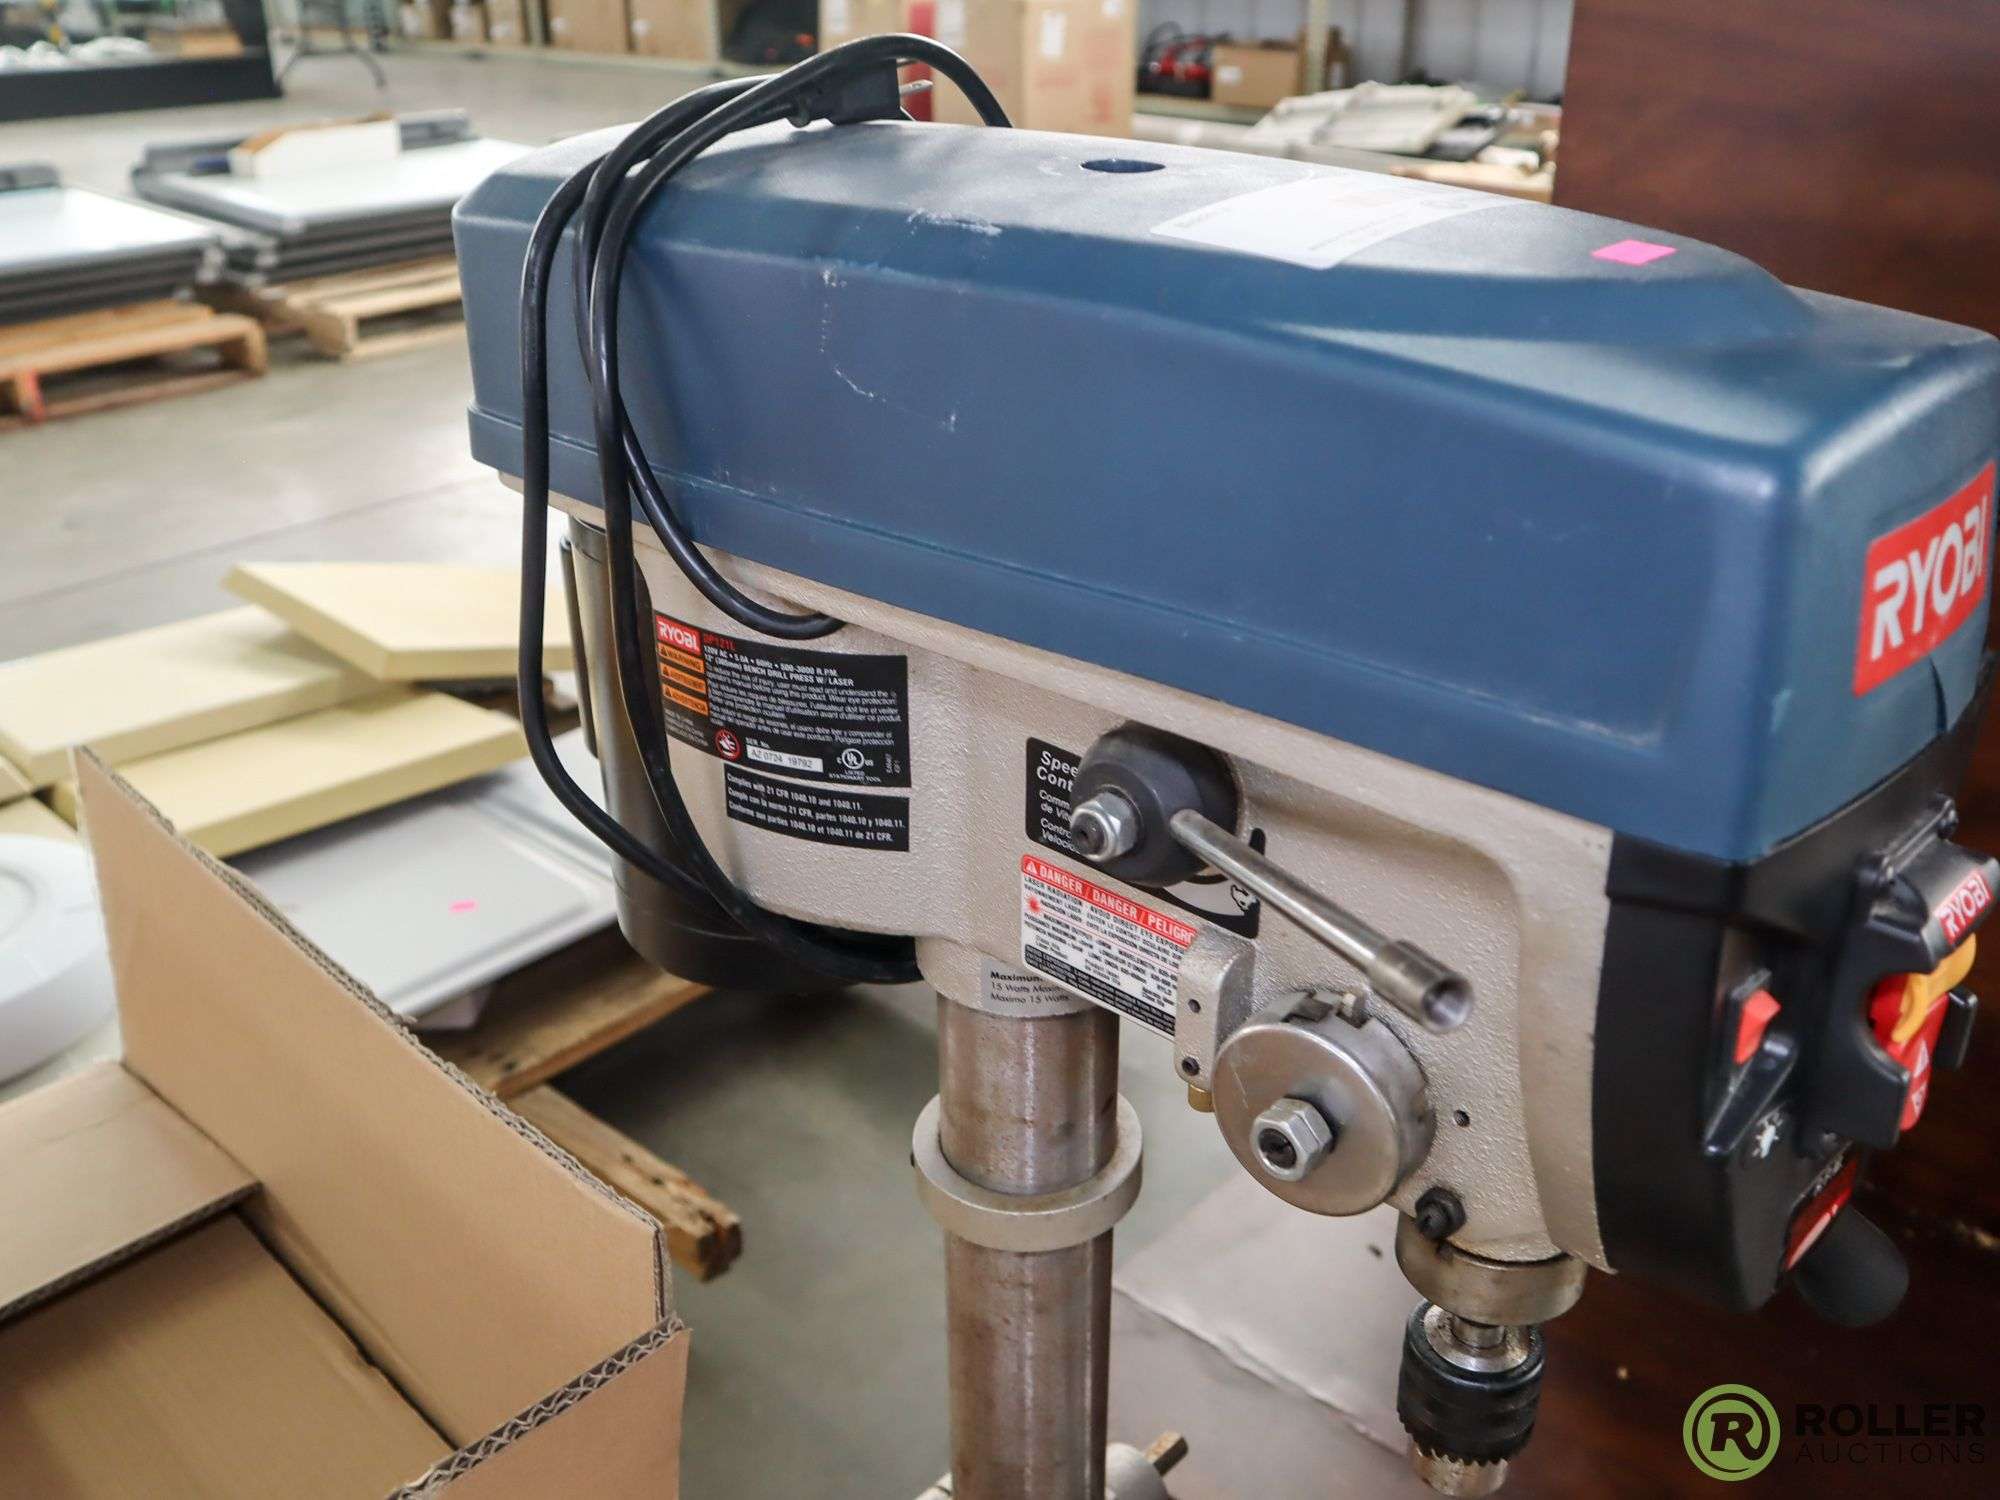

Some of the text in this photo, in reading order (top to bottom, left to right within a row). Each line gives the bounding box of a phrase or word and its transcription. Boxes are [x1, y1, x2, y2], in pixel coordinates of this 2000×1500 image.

[1871, 496, 1987, 661] RYOBI
[658, 620, 699, 652] RYOBI
[767, 669, 787, 679] DRILL
[789, 672, 814, 682] PRESS
[828, 677, 854, 686] LASER
[767, 785, 774, 794] 21
[776, 788, 789, 799] CFR
[818, 799, 831, 807] and
[788, 805, 796, 815] 21
[868, 819, 873, 827] y
[1041, 802, 1053, 814] de
[855, 831, 864, 839] de
[865, 831, 874, 840] 21
[1040, 866, 1083, 894] DANGER
[1093, 888, 1137, 920] DANGER
[1935, 871, 1990, 938] RYOBI
